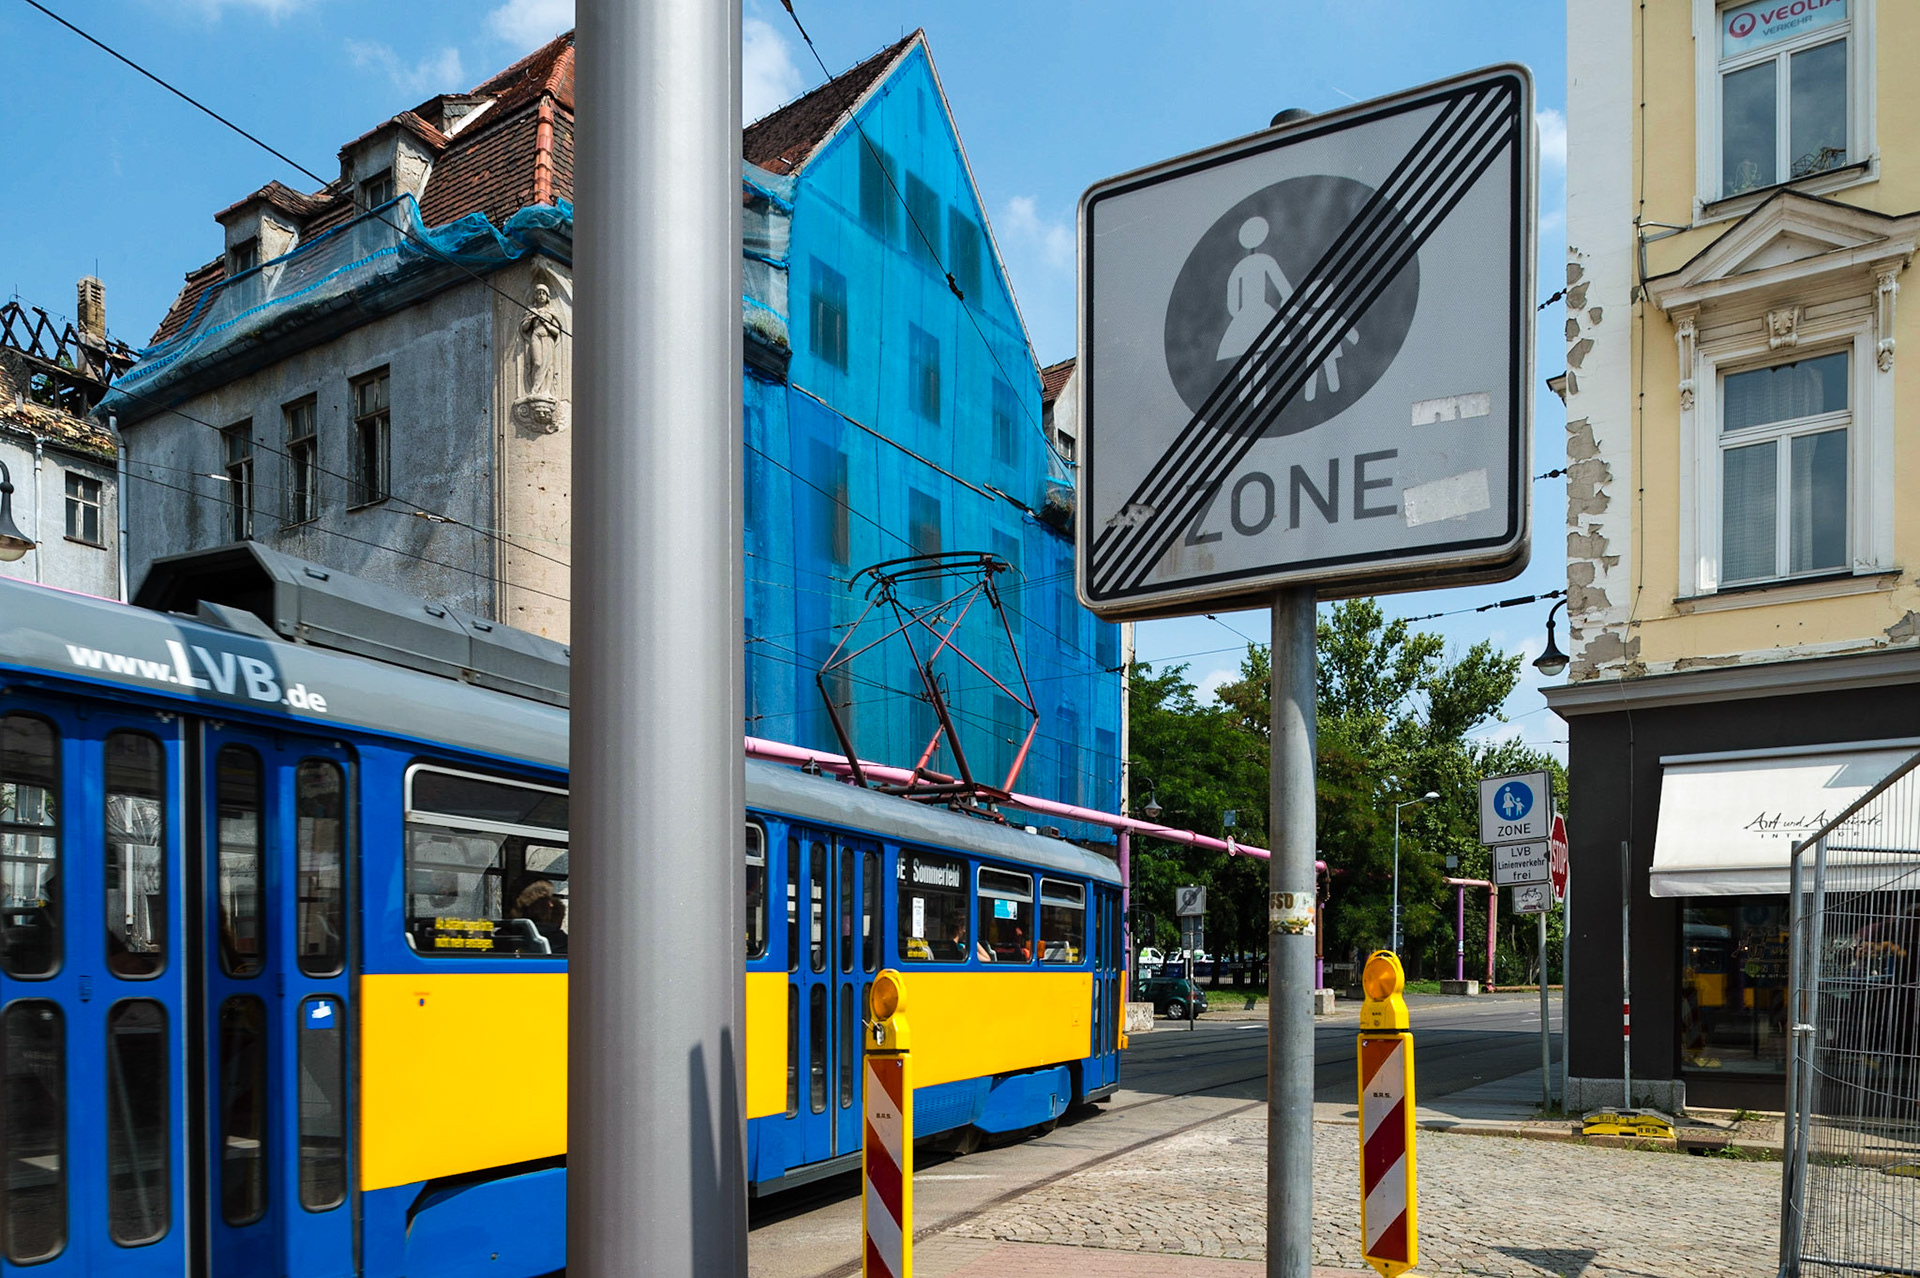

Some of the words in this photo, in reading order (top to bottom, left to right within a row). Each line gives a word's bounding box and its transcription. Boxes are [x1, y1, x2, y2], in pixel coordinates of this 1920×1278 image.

[1760, 0, 1841, 25] VEOLI
[1762, 15, 1813, 36] VERKEHR
[1184, 448, 1398, 547] ZONE
[65, 639, 328, 713] www.LVB.de
[1743, 811, 1782, 829] Art
[1783, 815, 1805, 827] und
[1497, 823, 1531, 837] ZONE
[1760, 831, 1860, 839] INTEOR
[1511, 846, 1531, 857] LVB
[1551, 838, 1567, 875] STOP
[913, 858, 960, 887] Sommerfeld
[1498, 858, 1546, 870] Linienverkehr
[1513, 870, 1531, 881] frei
